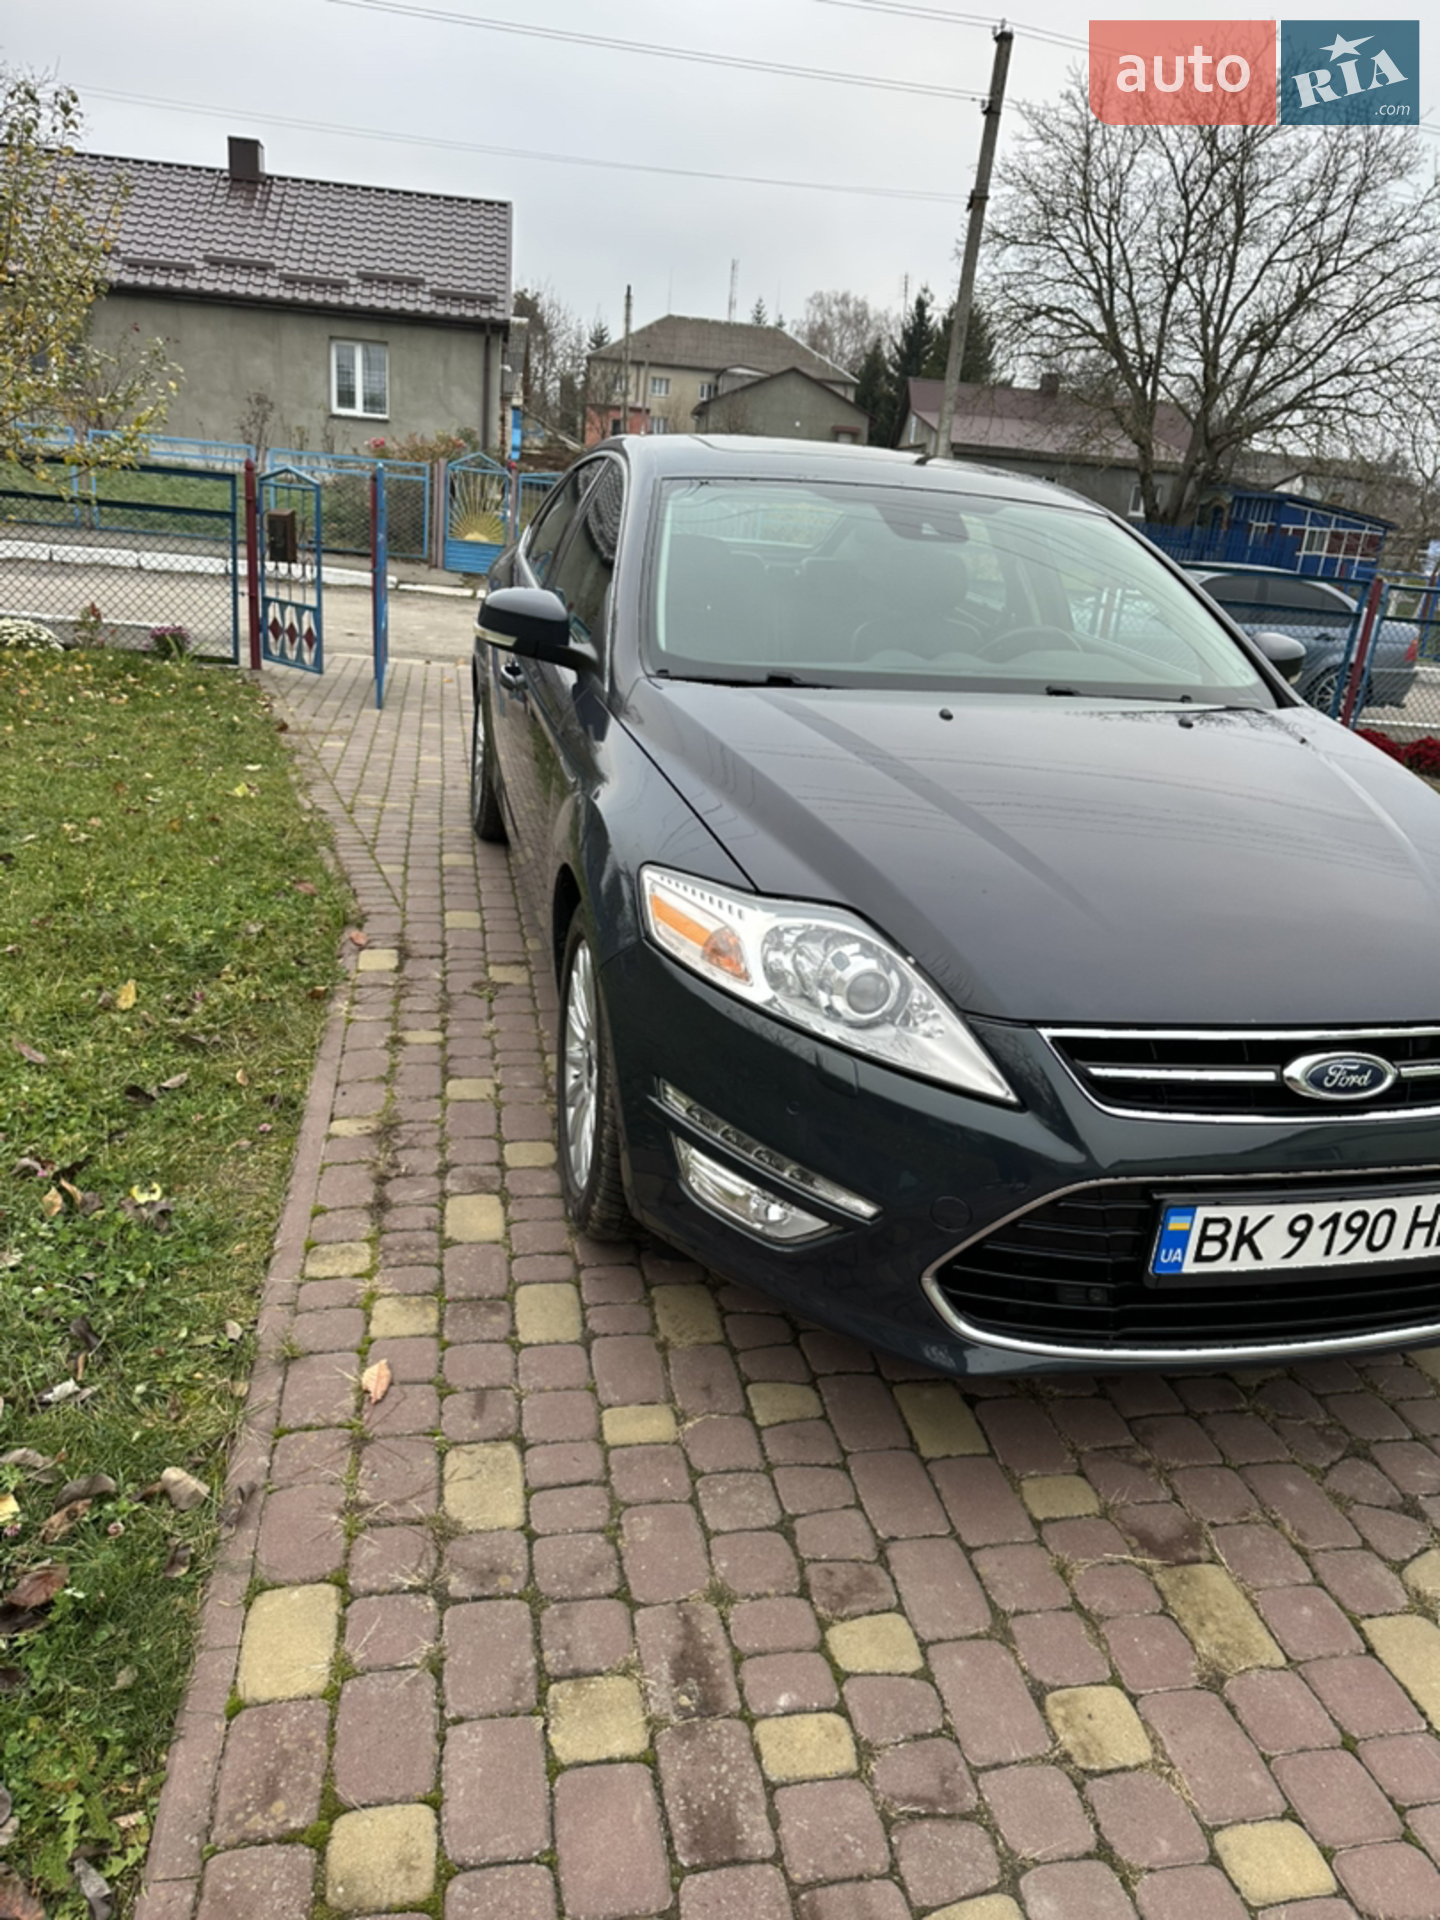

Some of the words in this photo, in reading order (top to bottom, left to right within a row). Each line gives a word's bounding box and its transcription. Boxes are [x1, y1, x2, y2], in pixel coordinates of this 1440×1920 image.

[1323, 1064, 1373, 1088] Ford
[1193, 1214, 1275, 1264] BK
[1280, 1207, 1398, 1260] 9190
[1402, 1203, 1440, 1251] H
[1160, 1248, 1183, 1264] UA
